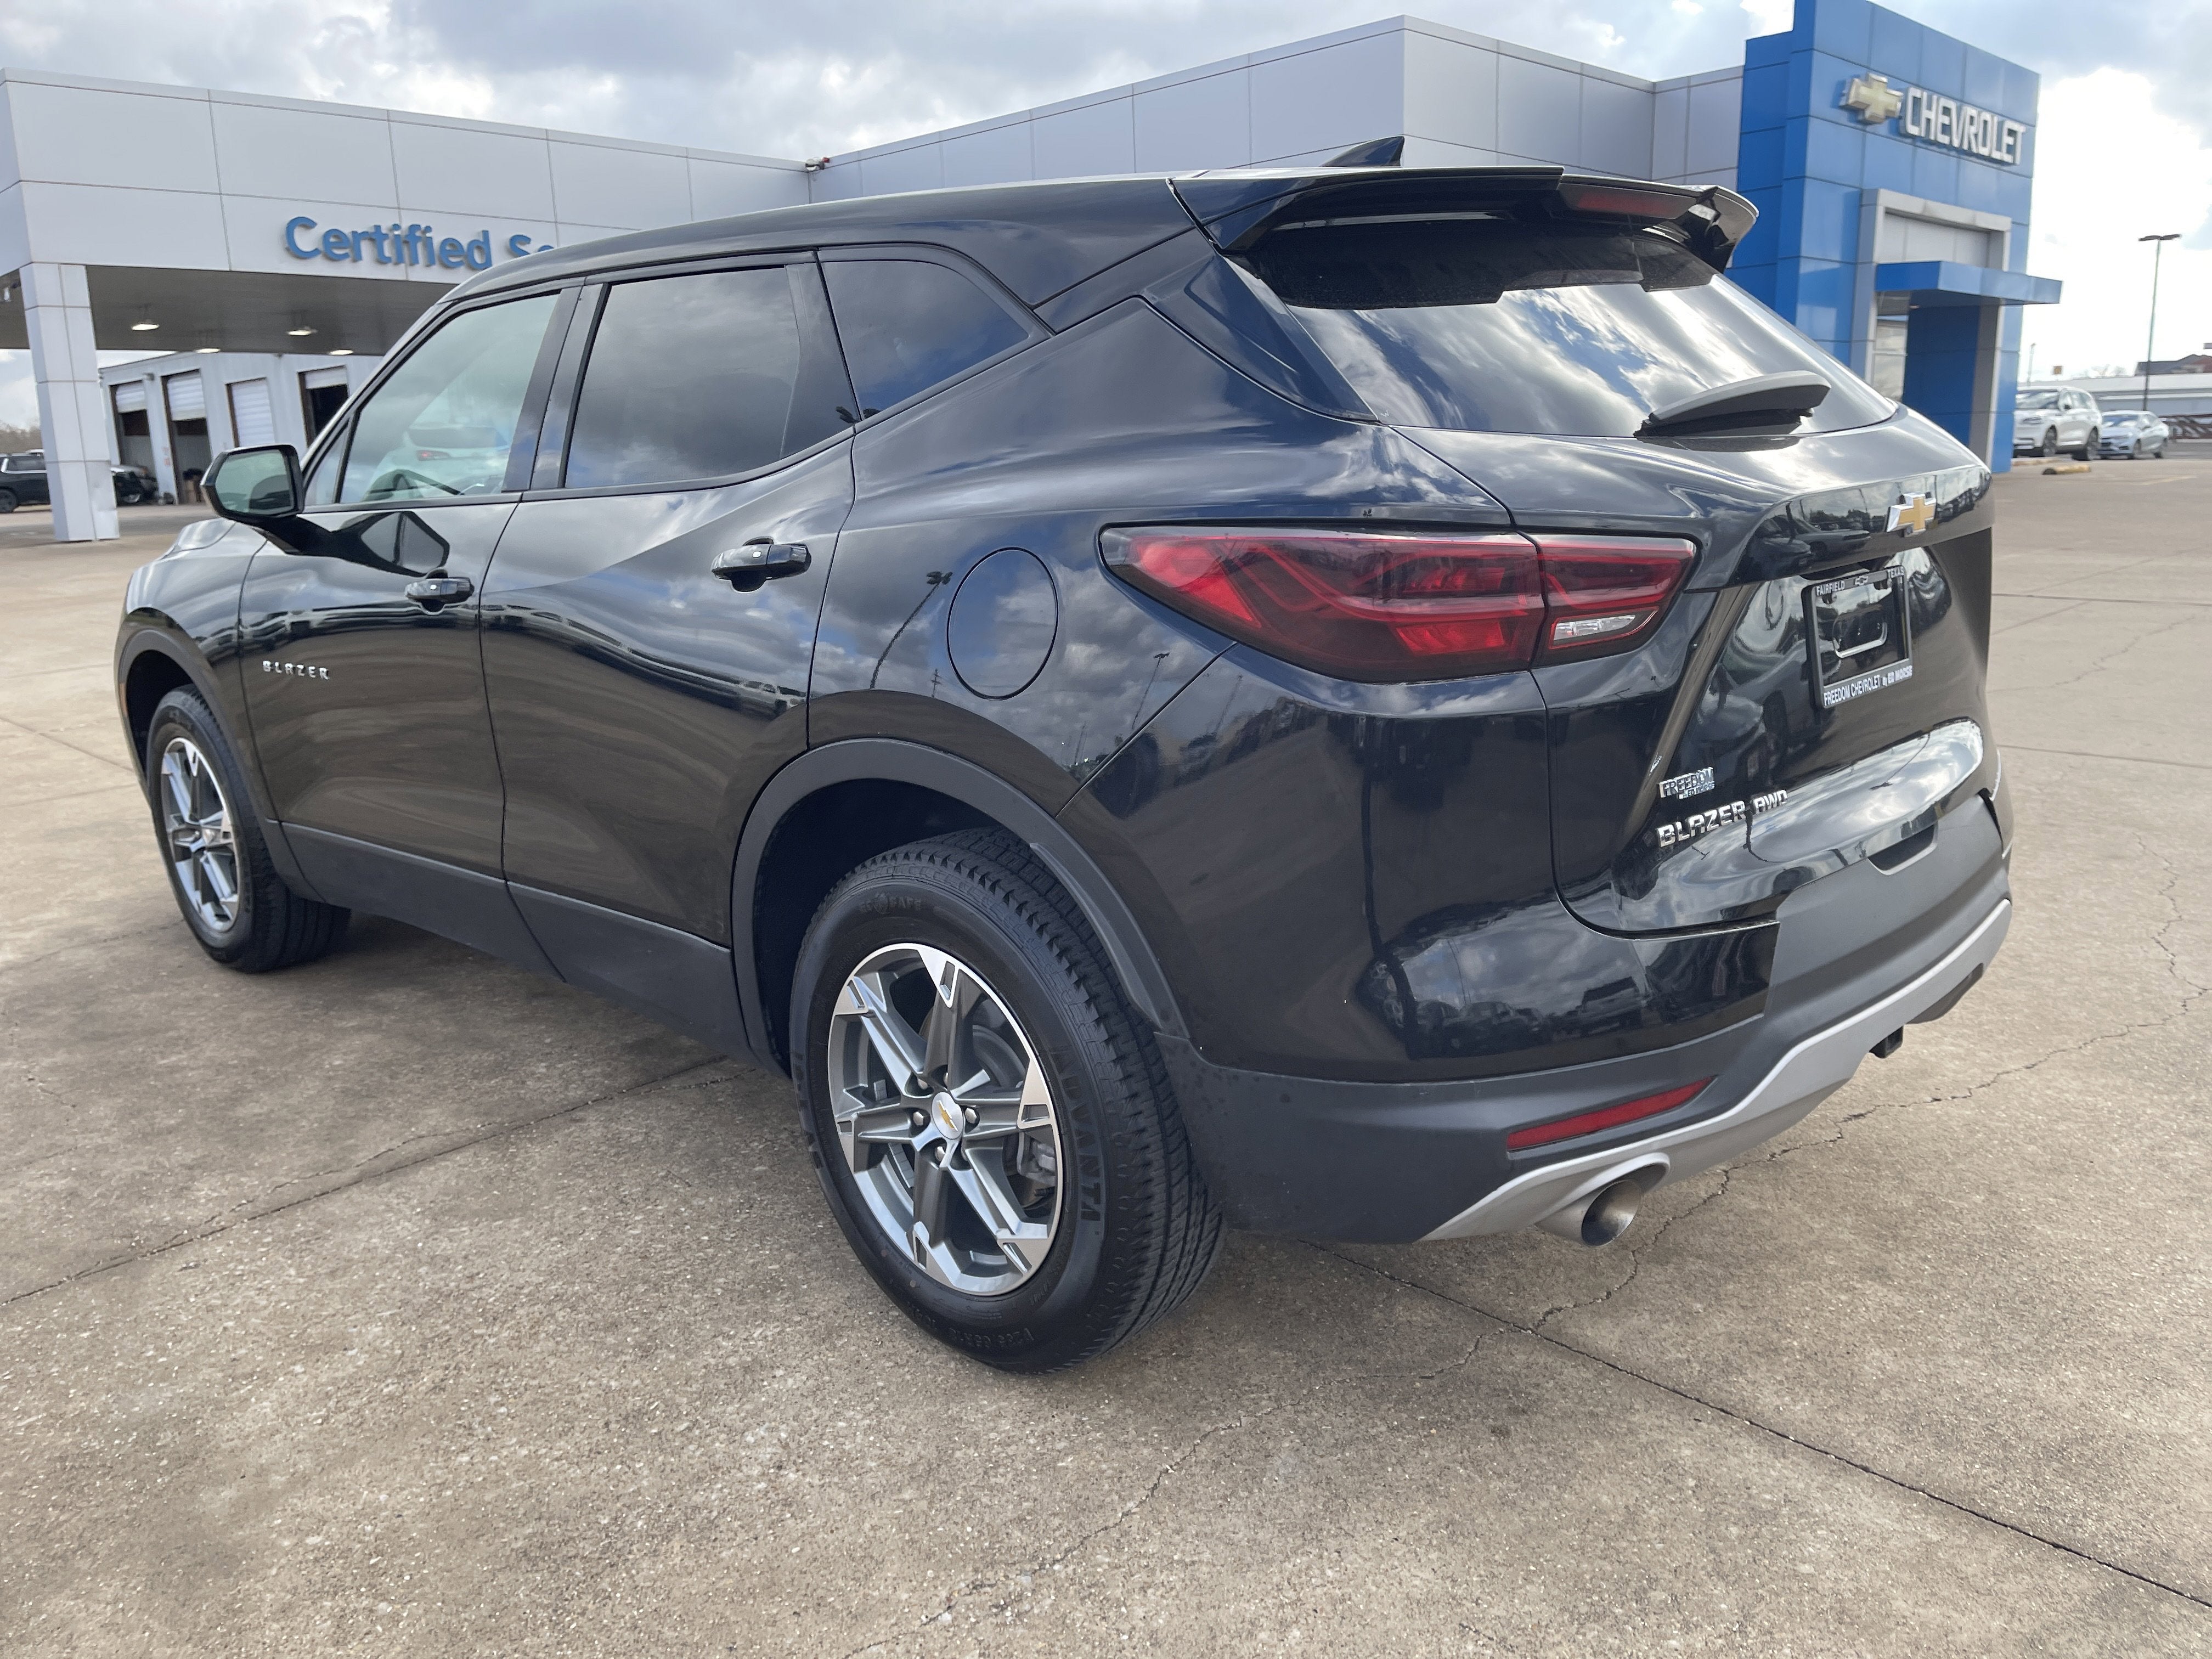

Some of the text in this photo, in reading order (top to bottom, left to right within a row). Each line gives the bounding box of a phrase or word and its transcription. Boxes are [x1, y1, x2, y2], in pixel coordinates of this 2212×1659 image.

[1905, 87, 2026, 165] CHEVROLET
[285, 216, 554, 270] Certified S
[1816, 566, 1905, 596] FAIRFIELD TEXAS
[263, 660, 330, 680] BLAZER
[1824, 686, 1851, 706] FREEDOM
[1851, 675, 1880, 697] CHEVROLET
[1659, 766, 1714, 798] FREEDOM
[1657, 789, 1788, 848] BLAZER AWD
